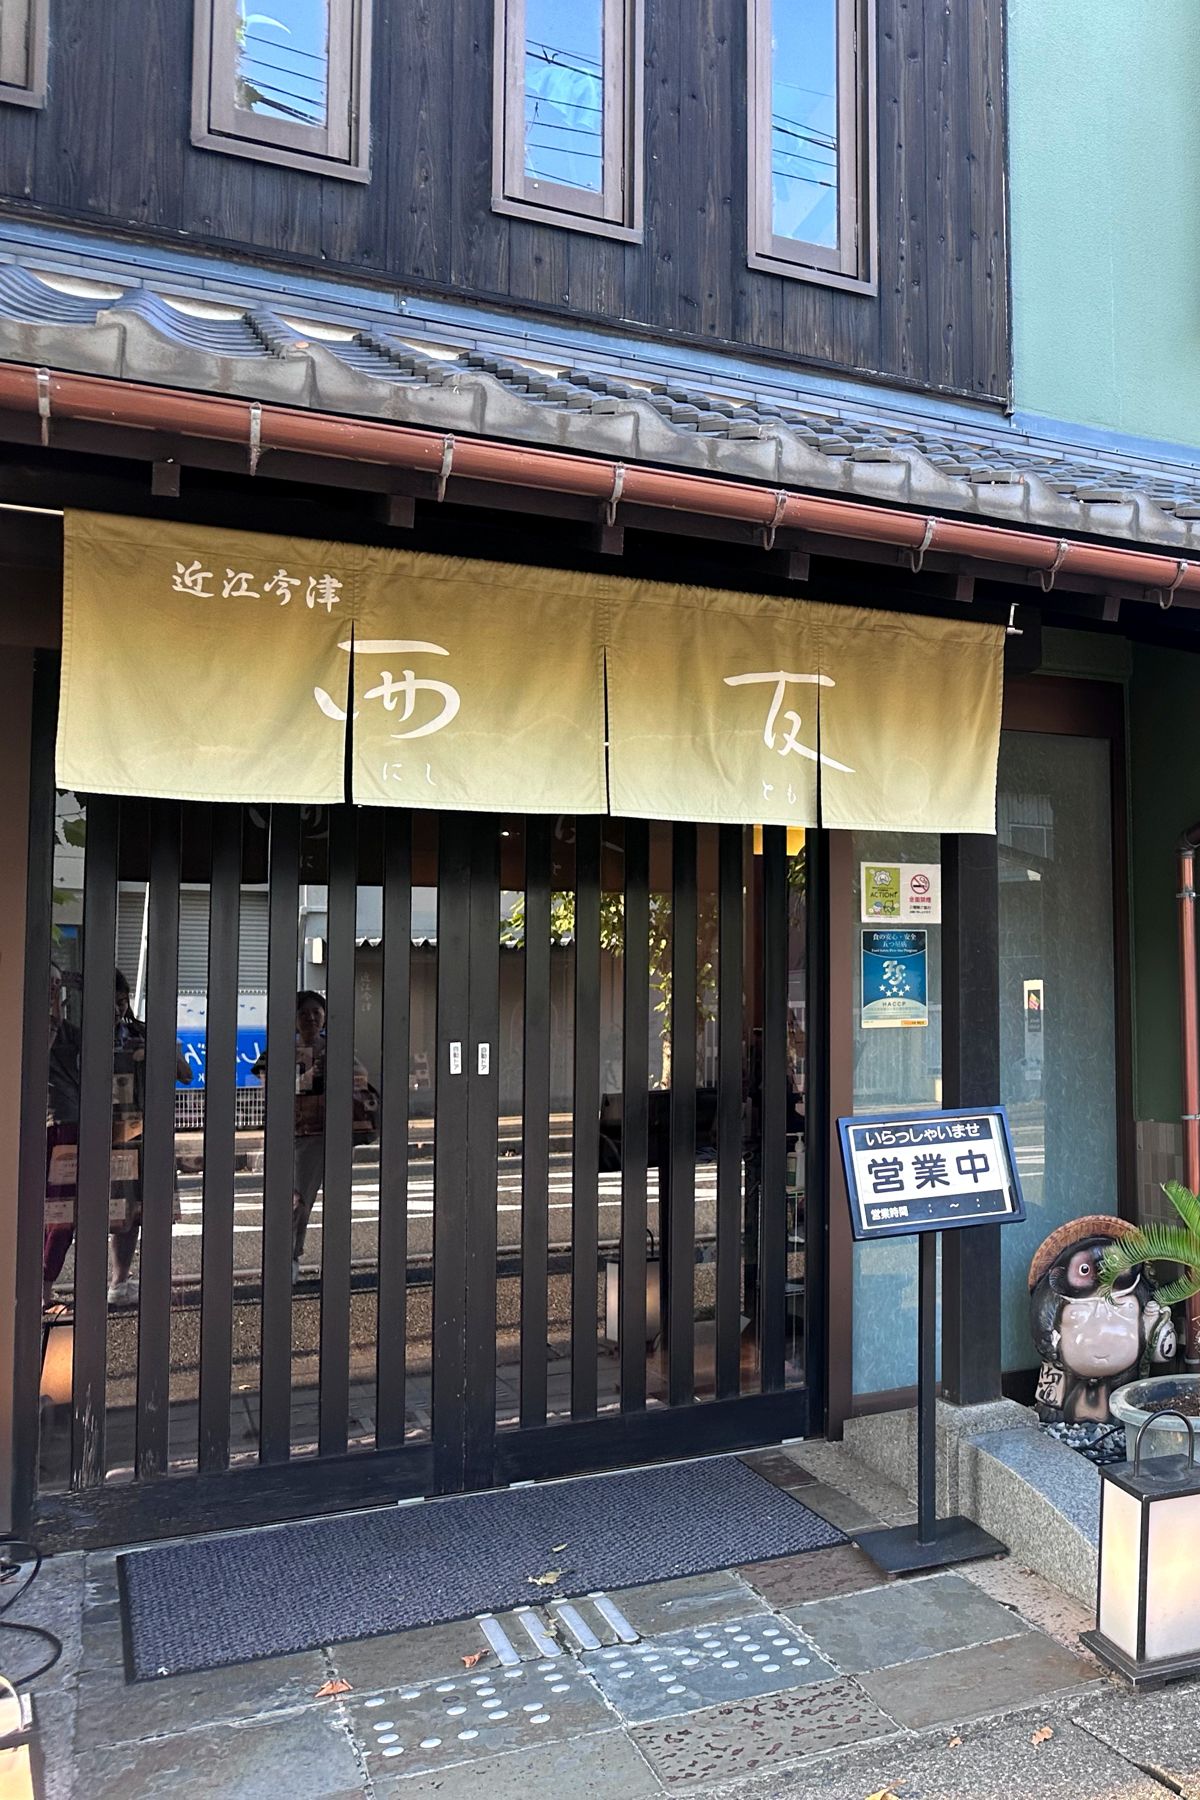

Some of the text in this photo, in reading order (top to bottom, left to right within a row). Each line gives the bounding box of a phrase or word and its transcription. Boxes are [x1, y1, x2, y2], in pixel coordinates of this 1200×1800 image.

[172, 560, 343, 613] 近江今津
[865, 1122, 981, 1147] いらっしゃいませ
[867, 1149, 990, 1194] 営業中
[870, 1205, 909, 1221] 営業時間
